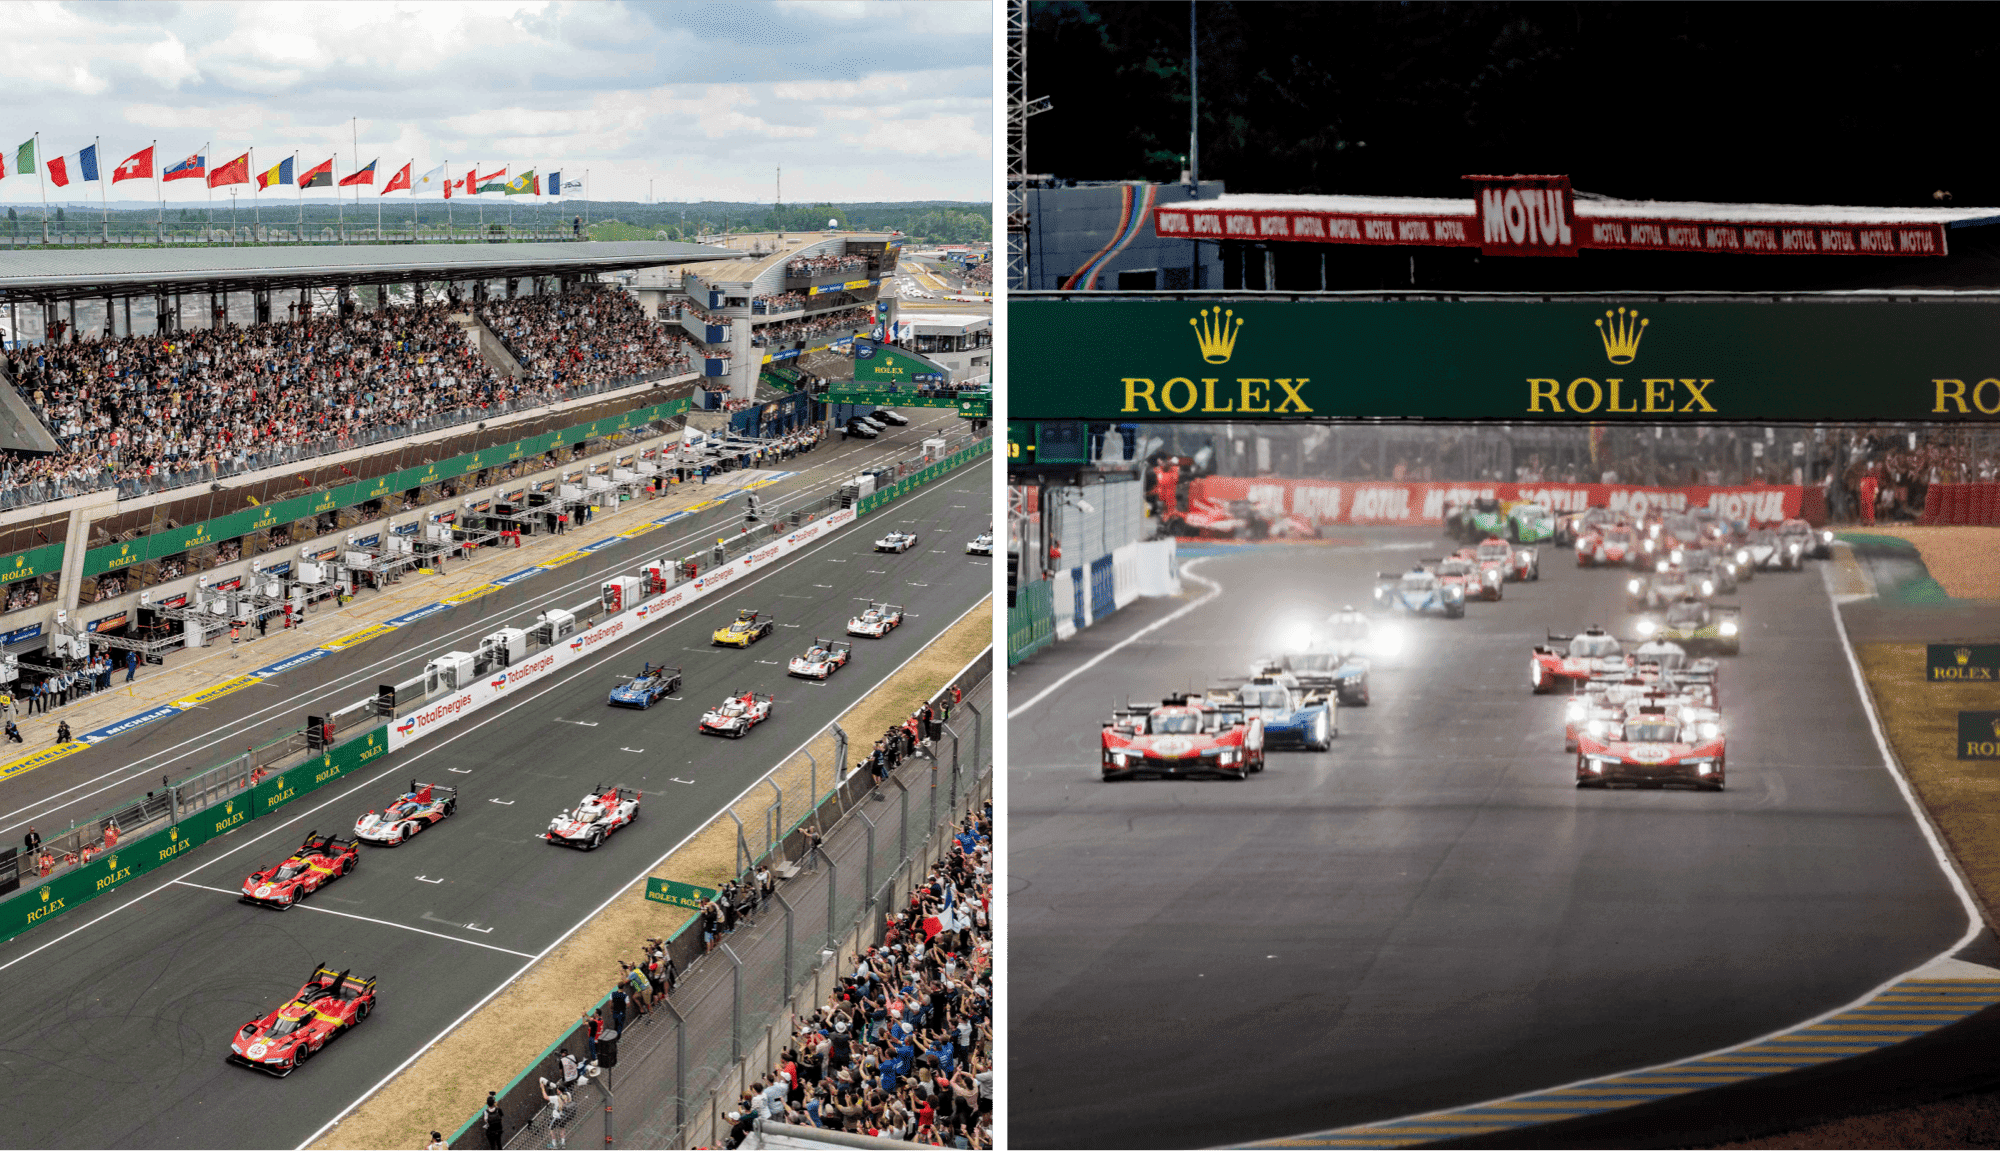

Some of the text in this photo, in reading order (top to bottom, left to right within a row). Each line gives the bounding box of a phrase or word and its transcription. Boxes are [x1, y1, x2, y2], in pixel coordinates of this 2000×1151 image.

[1160, 213, 1189, 232] MOTUL
[1193, 215, 1221, 233] MOTUL
[1226, 215, 1255, 235] MOTUL
[1261, 216, 1288, 236] MOTUL
[1295, 217, 1325, 237] MOTUL
[1482, 189, 1572, 246] MOTUL
[1330, 219, 1360, 239] MOTUL
[1365, 221, 1394, 239] MOTUL
[1399, 222, 1429, 240] MOTUL
[1435, 221, 1465, 240] MOTUL
[1594, 224, 1625, 244] MOTUL
[1631, 225, 1662, 245] MOTUL
[1668, 227, 1700, 247] MOTUL
[1706, 228, 1738, 248] MOTUL
[1744, 230, 1777, 250] MOTUL
[1783, 230, 1815, 250] MOTUL
[1822, 231, 1855, 251] MOTUL
[1861, 232, 1894, 251] MOTUL
[1900, 232, 1934, 252] MOTUL
[1120, 377, 1314, 414] ROLEX
[1526, 378, 1717, 414] ROLEX
[253, 517, 277, 529] ROLEX
[185, 534, 211, 547] ROLEX
[109, 554, 137, 568] ROLEX
[1, 567, 34, 582] ROLEX
[648, 592, 683, 616] TotalEnergies
[583, 620, 624, 648] TotalEnergies
[273, 651, 325, 672] MICHELIN
[507, 654, 554, 684] TotalEnergies
[1934, 667, 1991, 680] ROLEX
[196, 677, 253, 701] MICHELIN
[416, 694, 472, 728] TotalEnergies
[106, 708, 172, 735] MICHELIN
[4, 743, 79, 774] MICHELIN
[316, 765, 341, 783] ROLEX
[268, 787, 295, 807] ROLEX
[215, 811, 244, 832] ROLEX
[159, 838, 191, 860] ROLEX
[97, 866, 131, 891] ROLEX
[648, 891, 701, 908] ROLEX ROL
[27, 898, 65, 924] ROLEX
